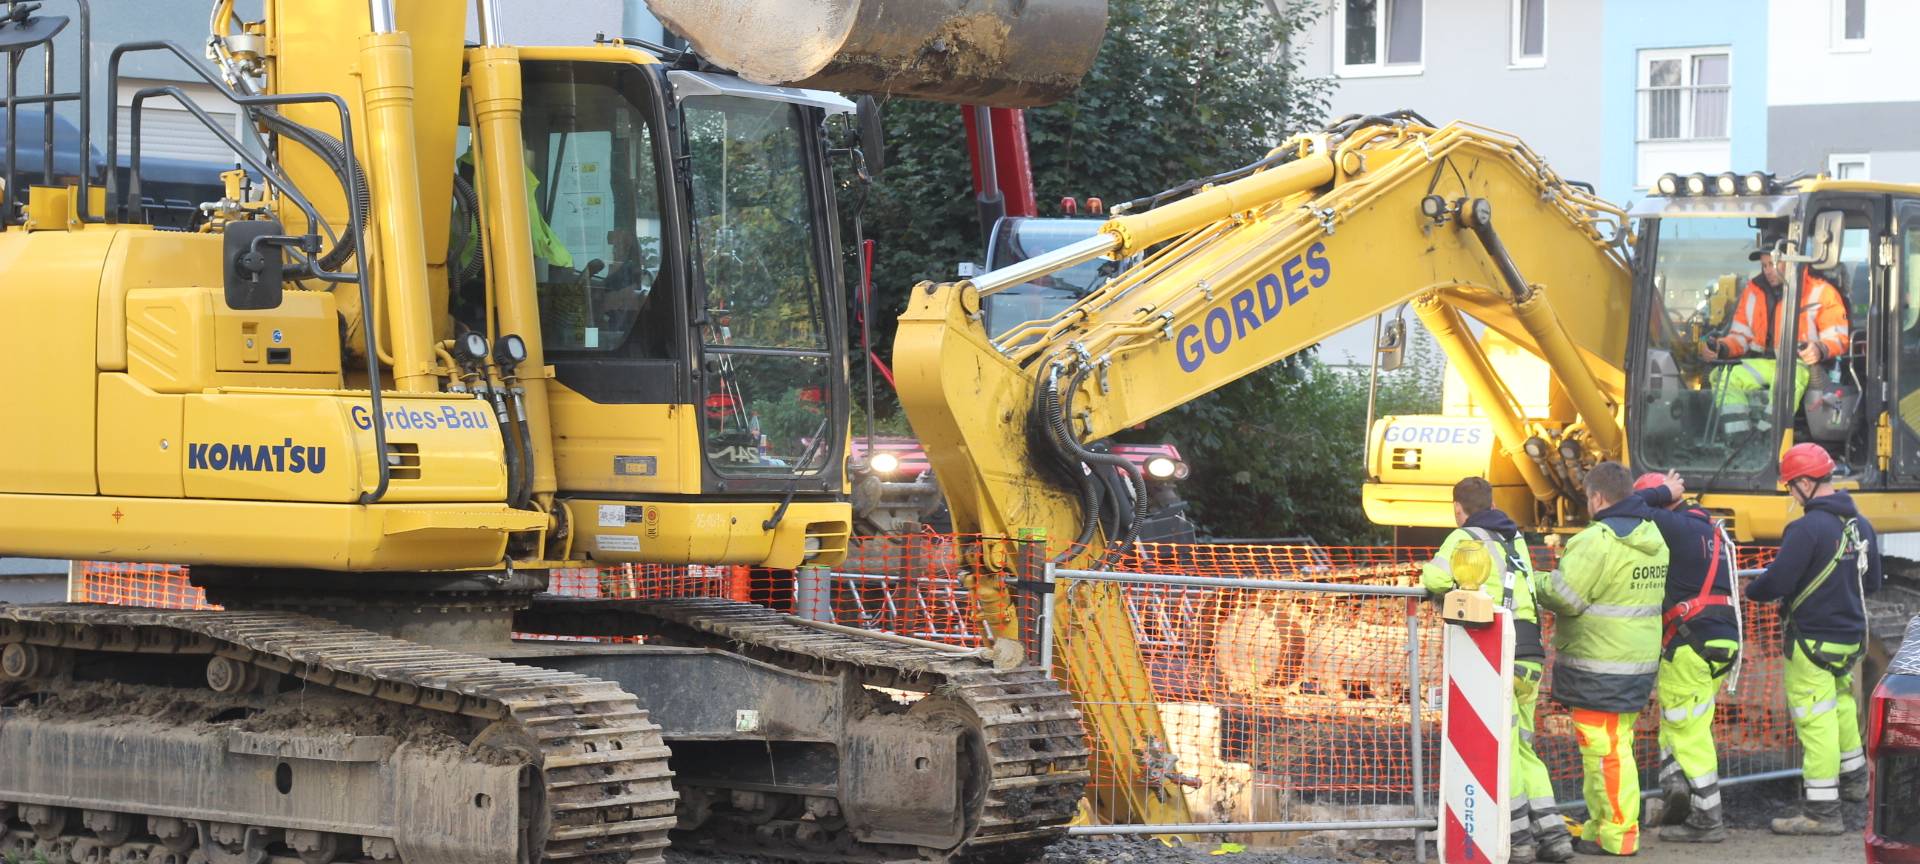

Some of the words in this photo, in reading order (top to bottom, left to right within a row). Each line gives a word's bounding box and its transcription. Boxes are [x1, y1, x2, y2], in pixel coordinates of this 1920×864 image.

[1176, 241, 1331, 373] GORDES
[188, 437, 326, 474] KOMATSU
[1384, 426, 1481, 444] GORDES
[1464, 784, 1475, 860] GORD
